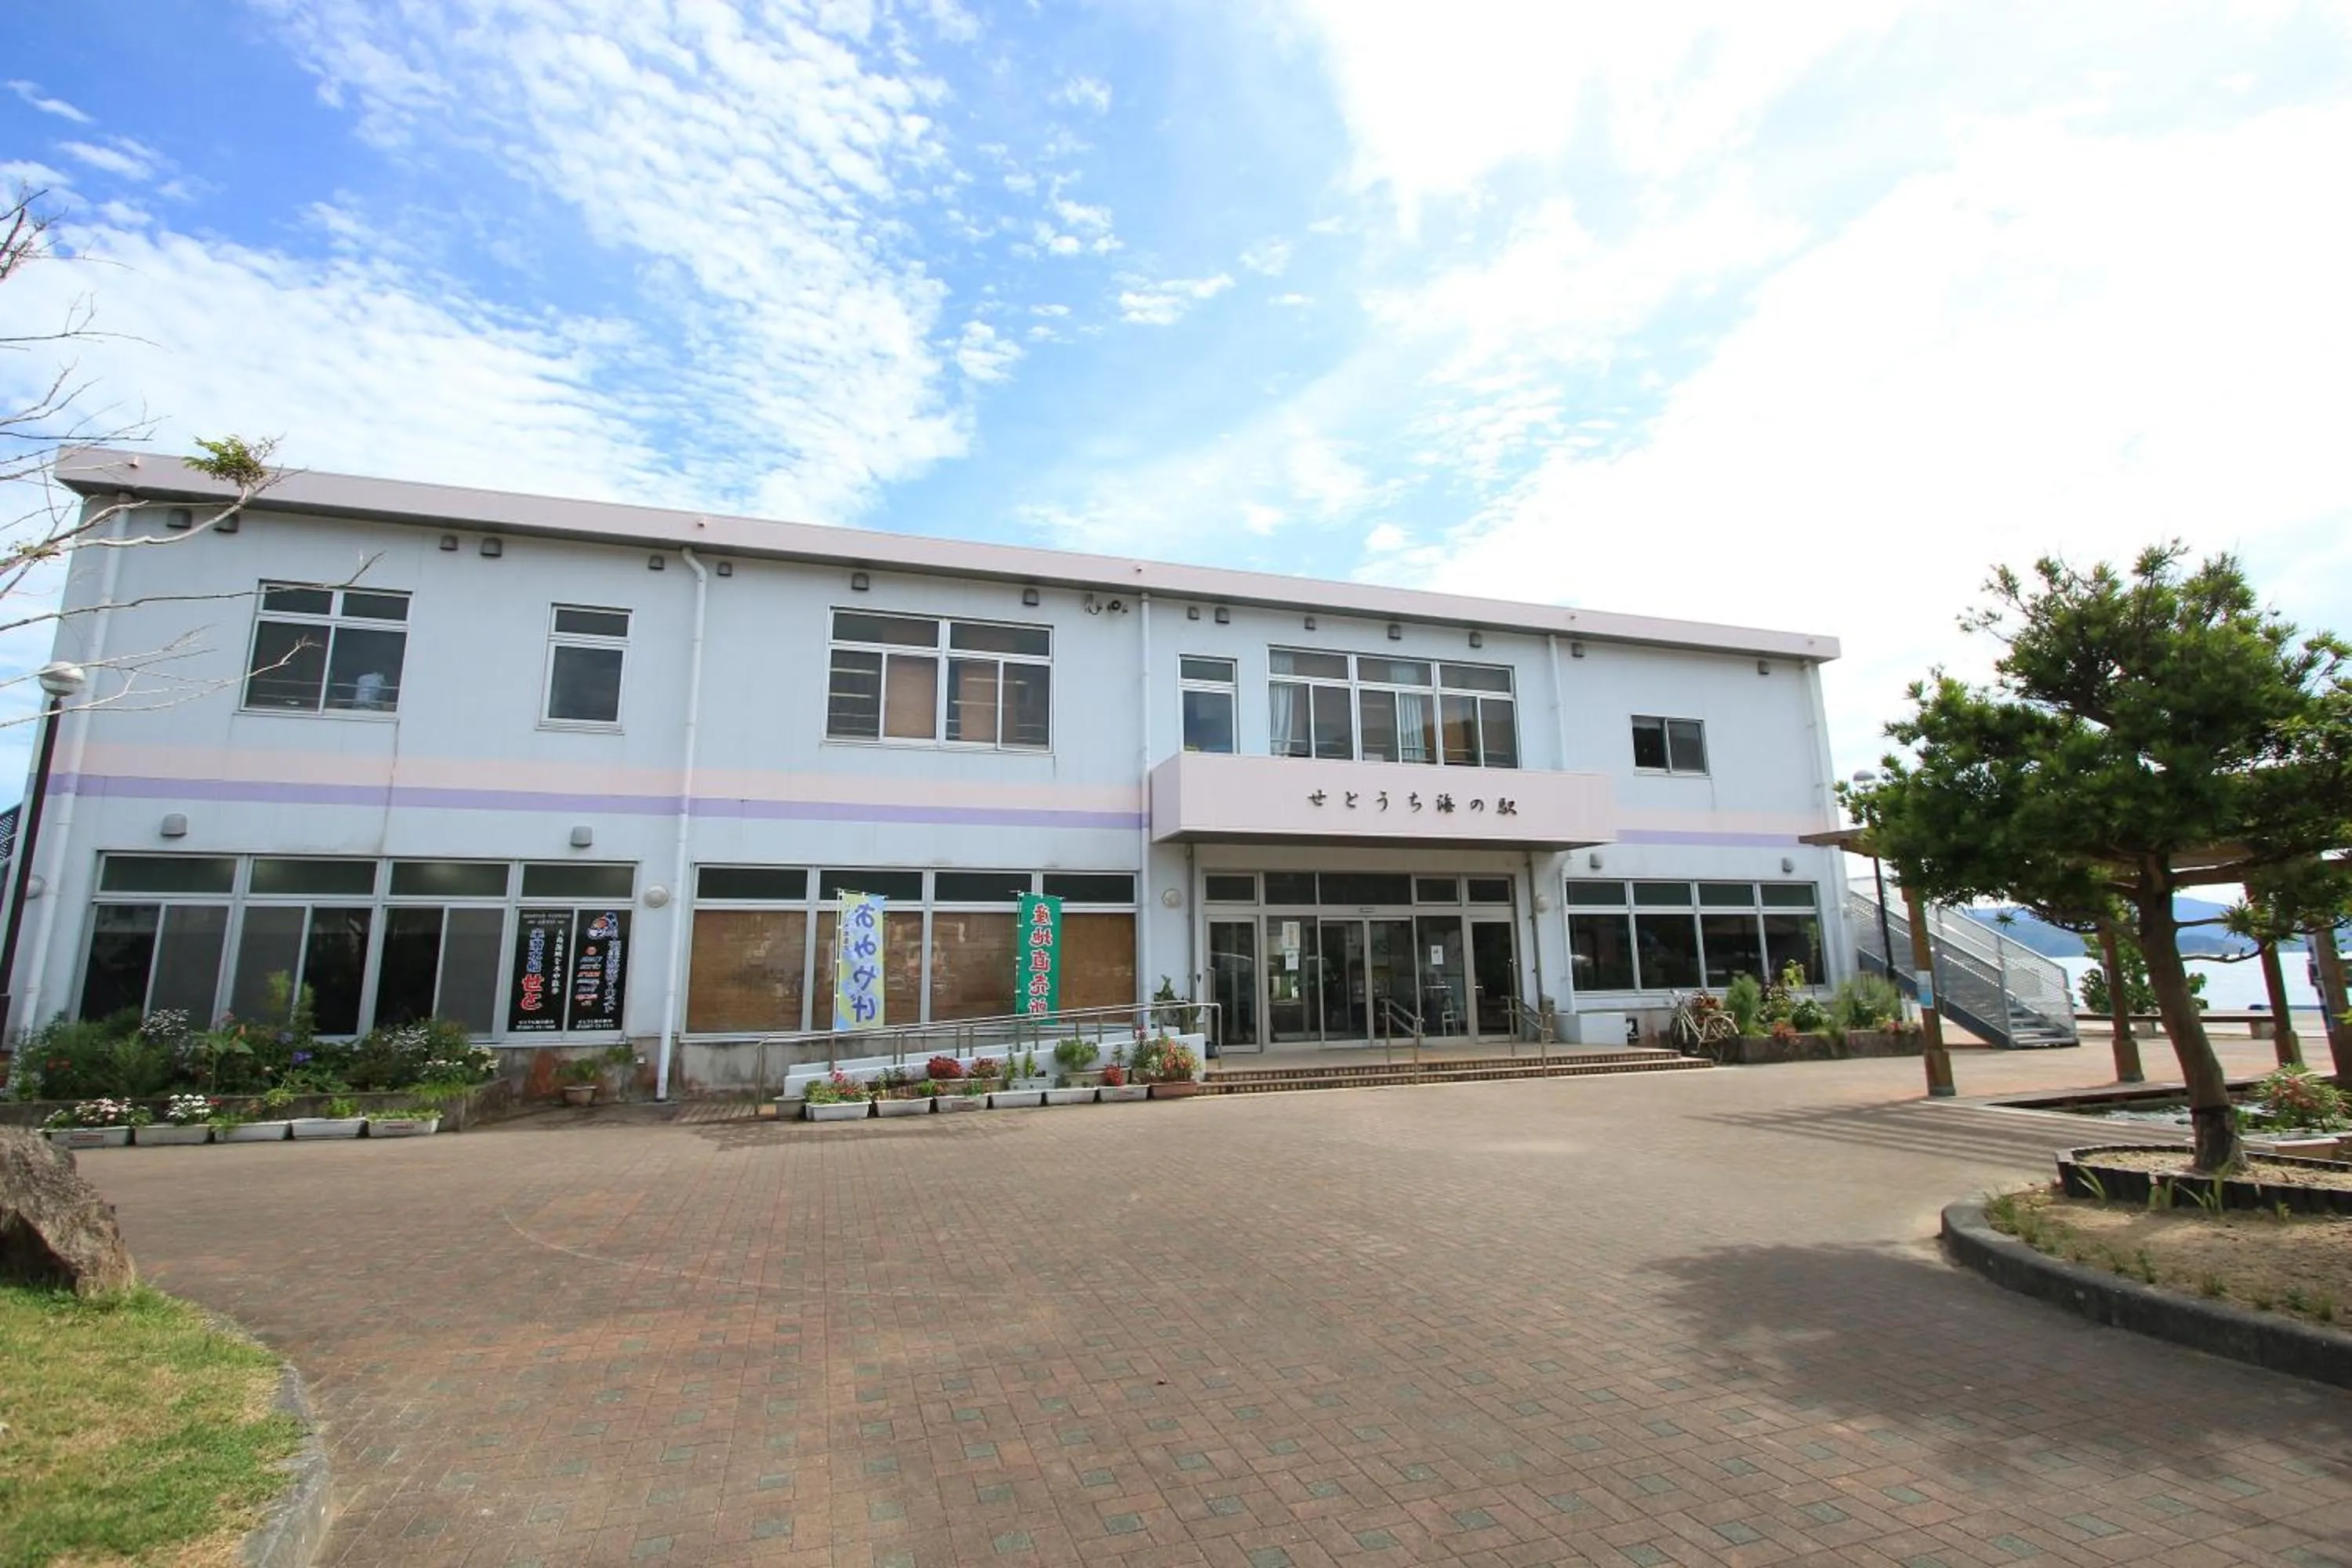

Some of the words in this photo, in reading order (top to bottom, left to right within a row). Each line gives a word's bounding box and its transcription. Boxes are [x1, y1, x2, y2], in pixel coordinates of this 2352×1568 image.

[1308, 789, 1518, 815] せとうち海の駅
